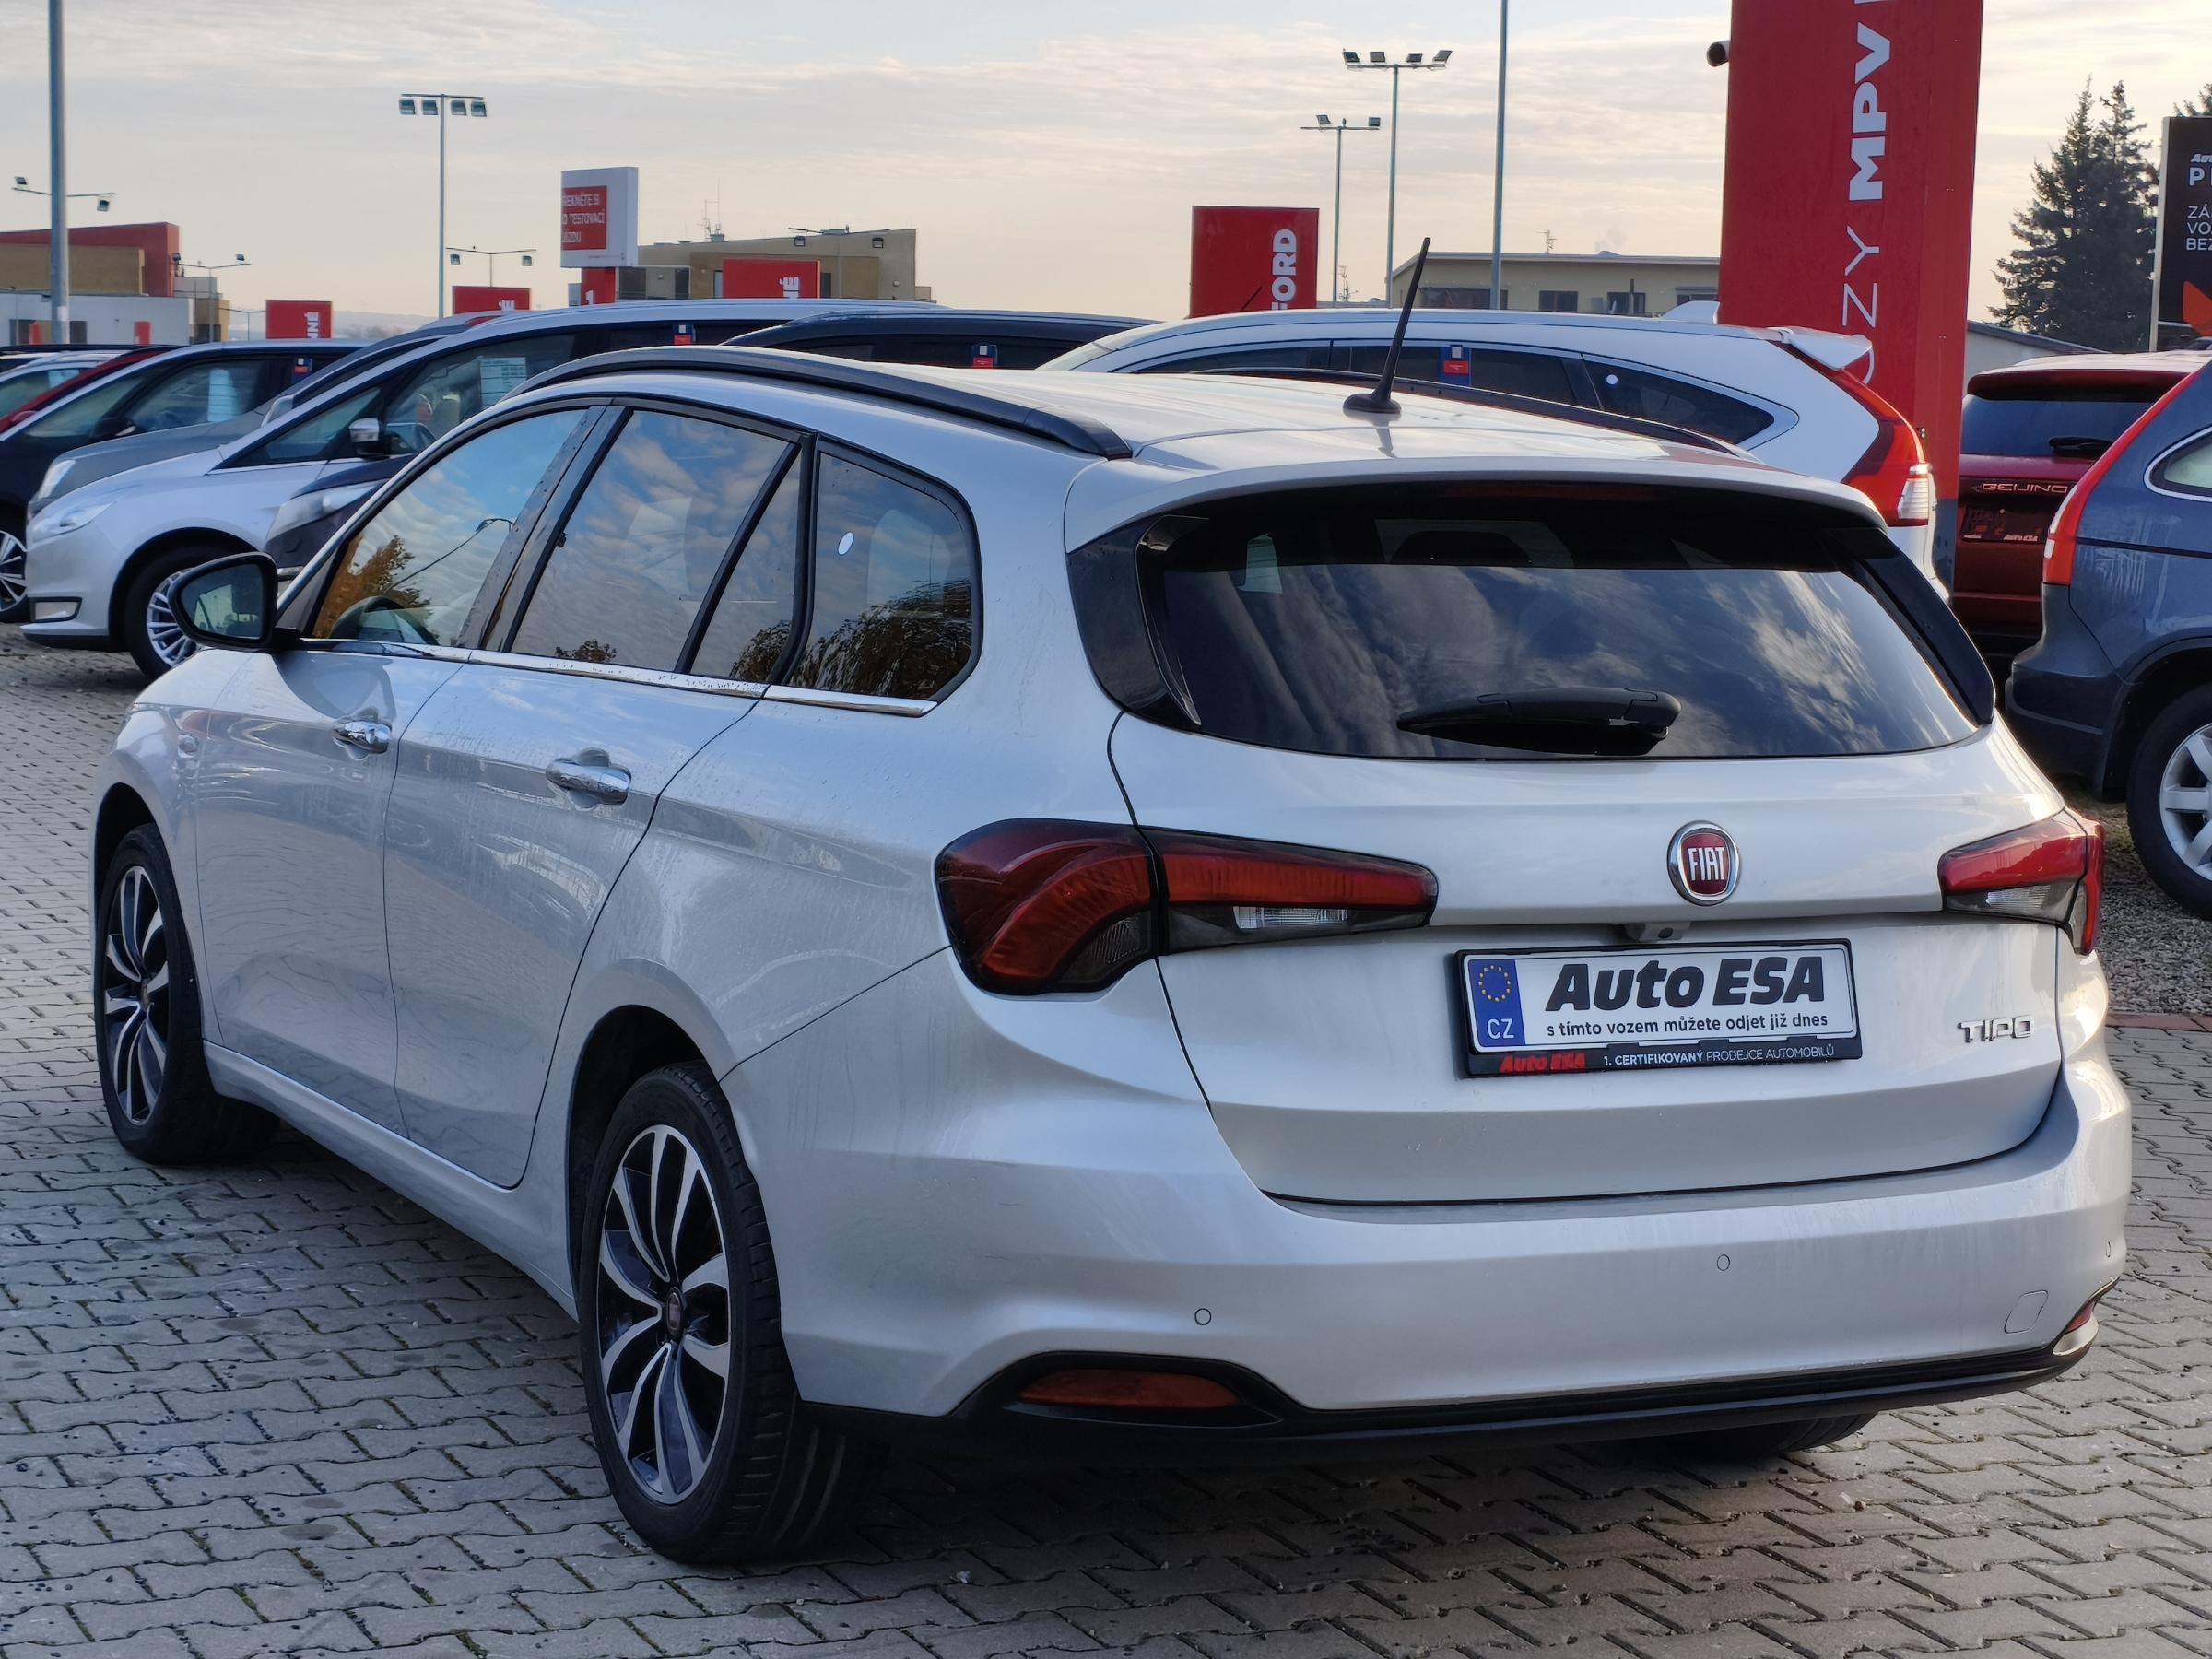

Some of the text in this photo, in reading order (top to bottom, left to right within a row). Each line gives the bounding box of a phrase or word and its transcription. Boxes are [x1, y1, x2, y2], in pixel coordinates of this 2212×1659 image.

[1849, 21, 1890, 201] MPV
[2187, 203, 2212, 218] ZÁ
[2187, 221, 2212, 235] VO
[1842, 226, 1880, 385] ZY
[1982, 483, 2068, 494] BEIJING
[1688, 846, 1725, 881] FIAT
[1545, 956, 1825, 1012] Auto ESA
[1487, 1018, 1515, 1040] CZ
[1547, 1012, 1829, 1037] s tímto vozem můžete odjet již dnes
[1957, 1015, 2035, 1043] TIPO
[1499, 1053, 1548, 1073] Auto
[1604, 1043, 1834, 1067] 1. CERTIFIKOVANÝ PRODEJCE AUTOMOBILŮ
